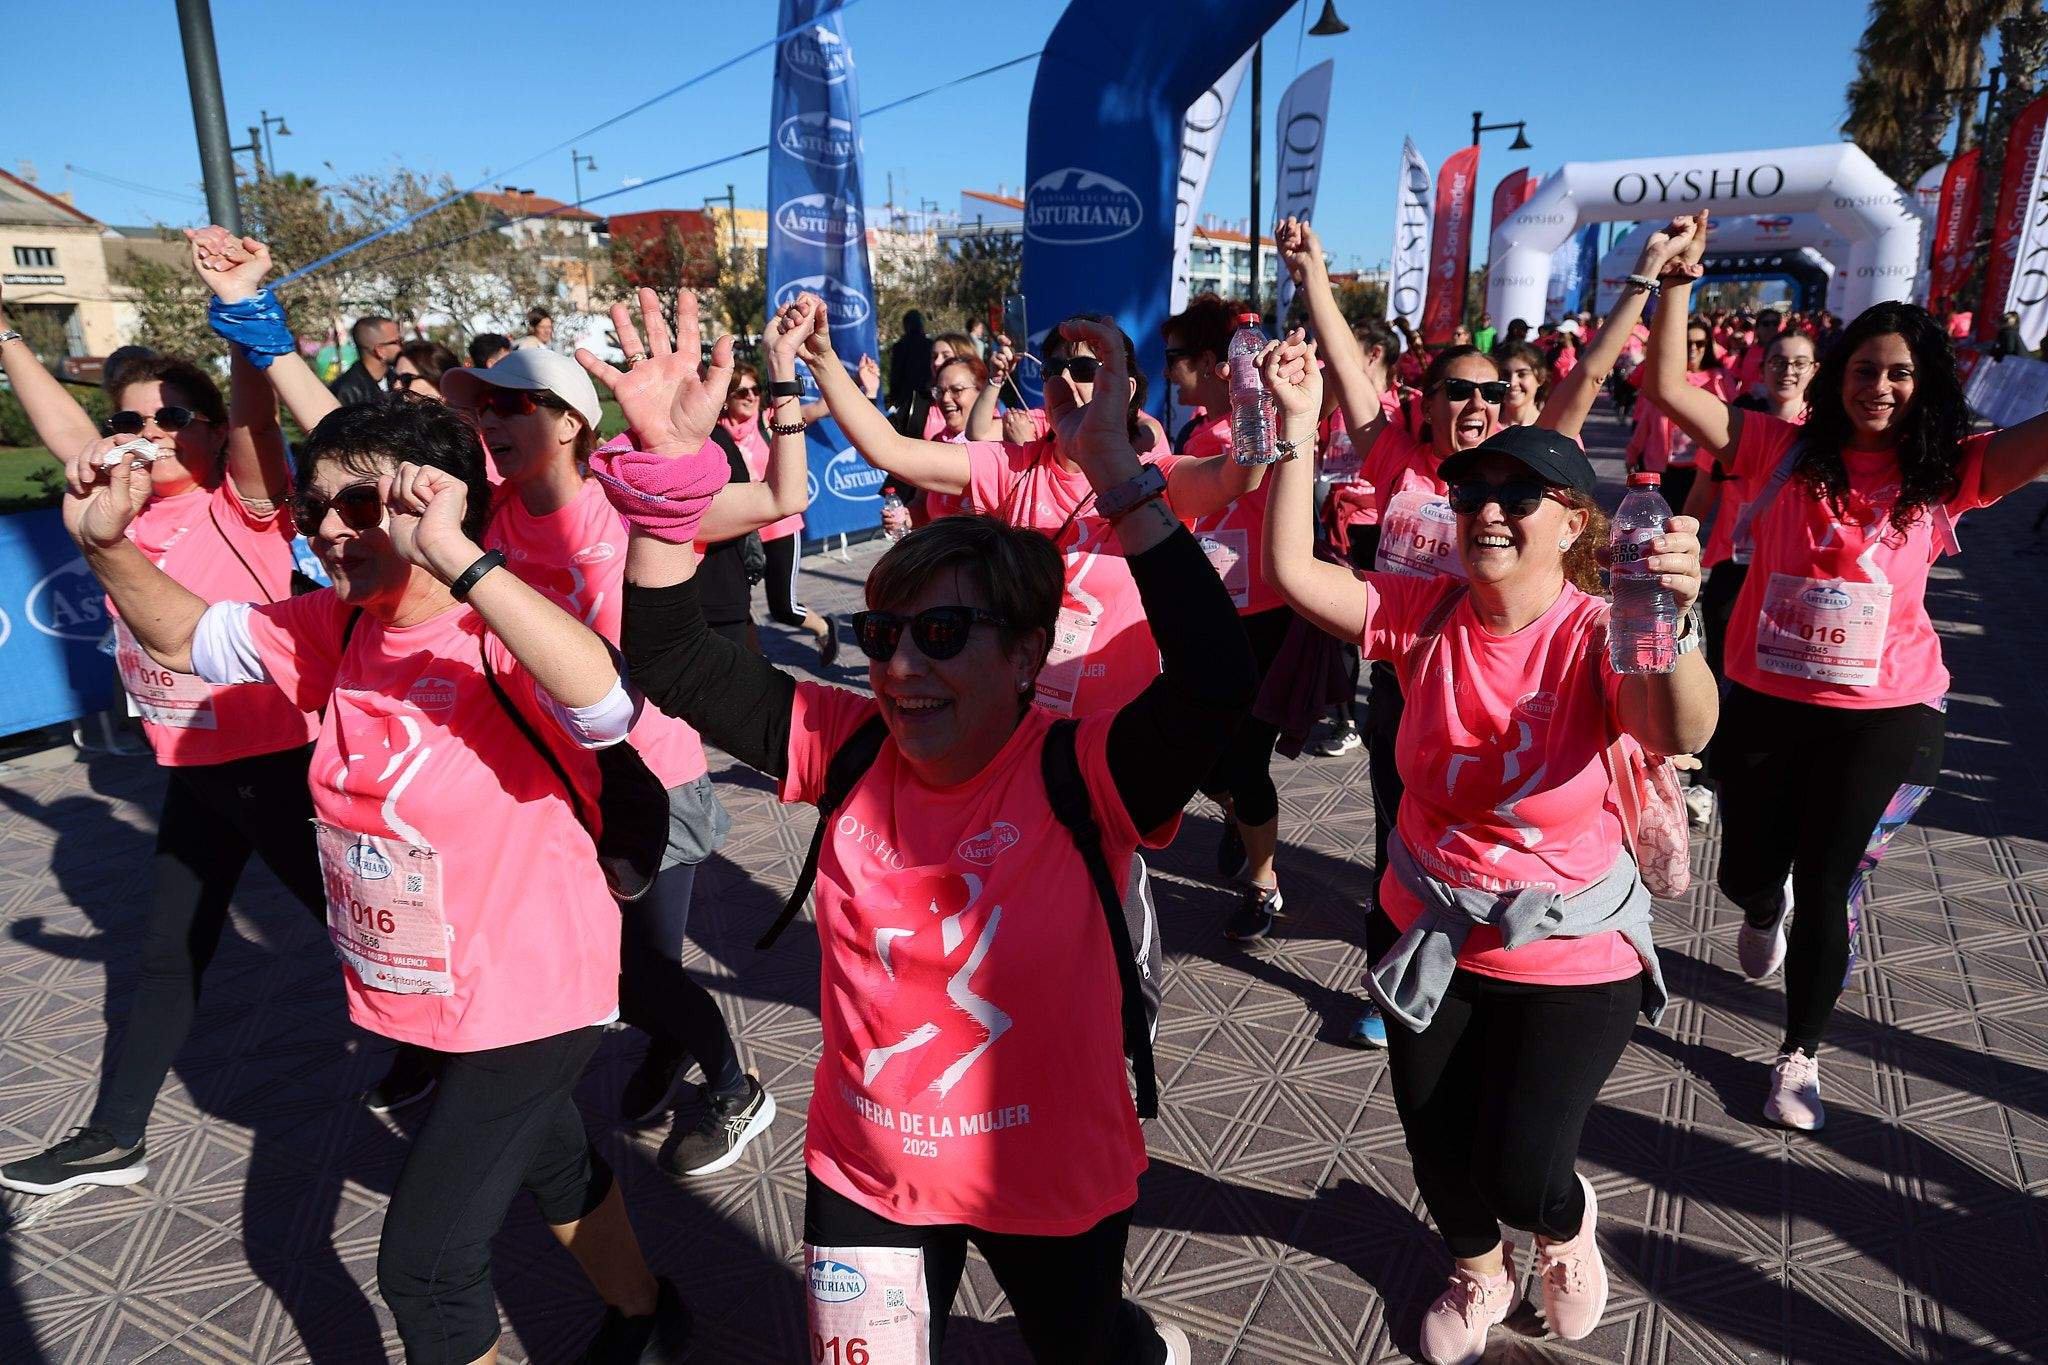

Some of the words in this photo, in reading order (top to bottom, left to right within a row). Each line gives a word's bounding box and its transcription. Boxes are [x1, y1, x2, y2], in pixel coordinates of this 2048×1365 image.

[1613, 164, 1785, 206] OYSHO
[1029, 198, 1133, 226] ASTURIANA
[833, 468, 887, 491] ASTURIA
[1413, 535, 1451, 557] 016
[1801, 624, 1847, 644] 016
[141, 667, 174, 687] 016
[838, 815, 906, 870] OYSHO
[1482, 875, 1501, 892] LA
[350, 900, 395, 934] 016
[900, 1111, 924, 1136] DE
[929, 1117, 954, 1138] LA
[959, 1104, 1031, 1137] MUJER
[903, 1137, 938, 1158] 2025
[811, 1279, 861, 1293] STURIANA
[813, 1332, 870, 1365] 016
